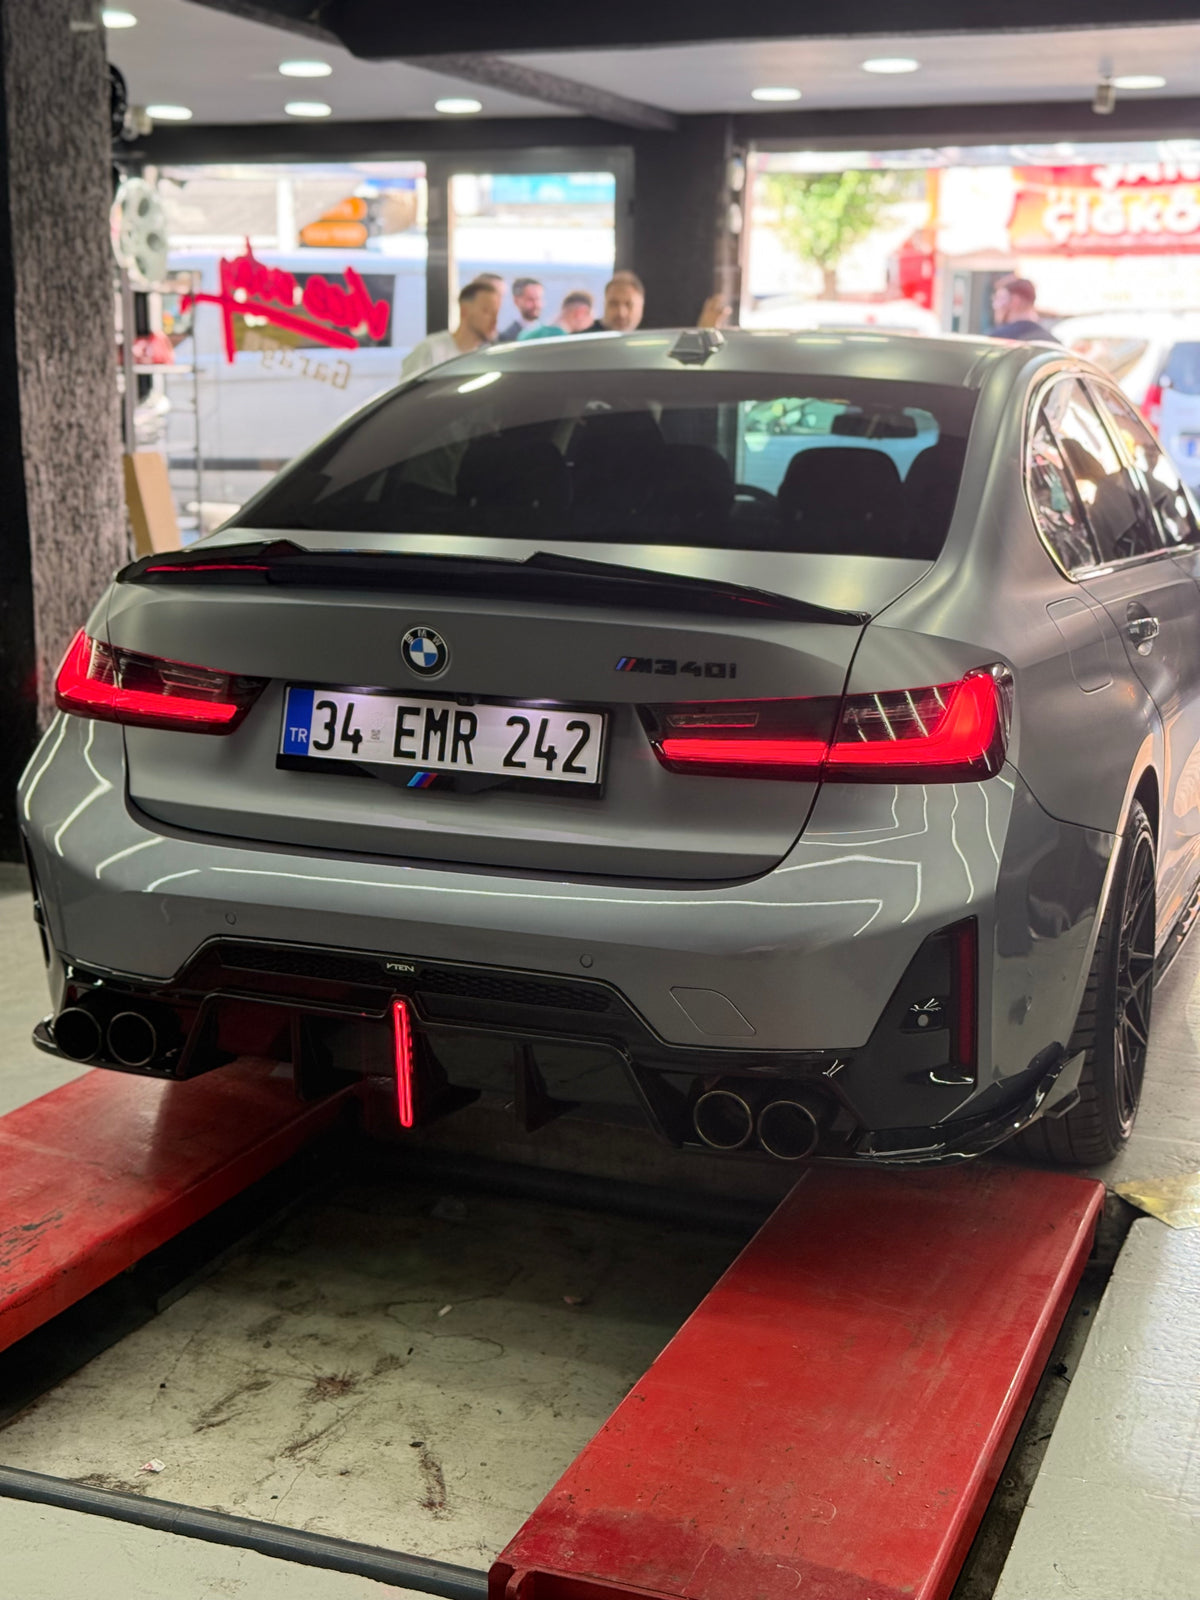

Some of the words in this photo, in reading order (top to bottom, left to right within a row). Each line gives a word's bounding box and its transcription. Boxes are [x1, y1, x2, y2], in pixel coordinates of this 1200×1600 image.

[289, 726, 307, 743] TR
[312, 700, 363, 754] 34
[393, 706, 478, 765] EMR
[502, 715, 591, 774] 242
